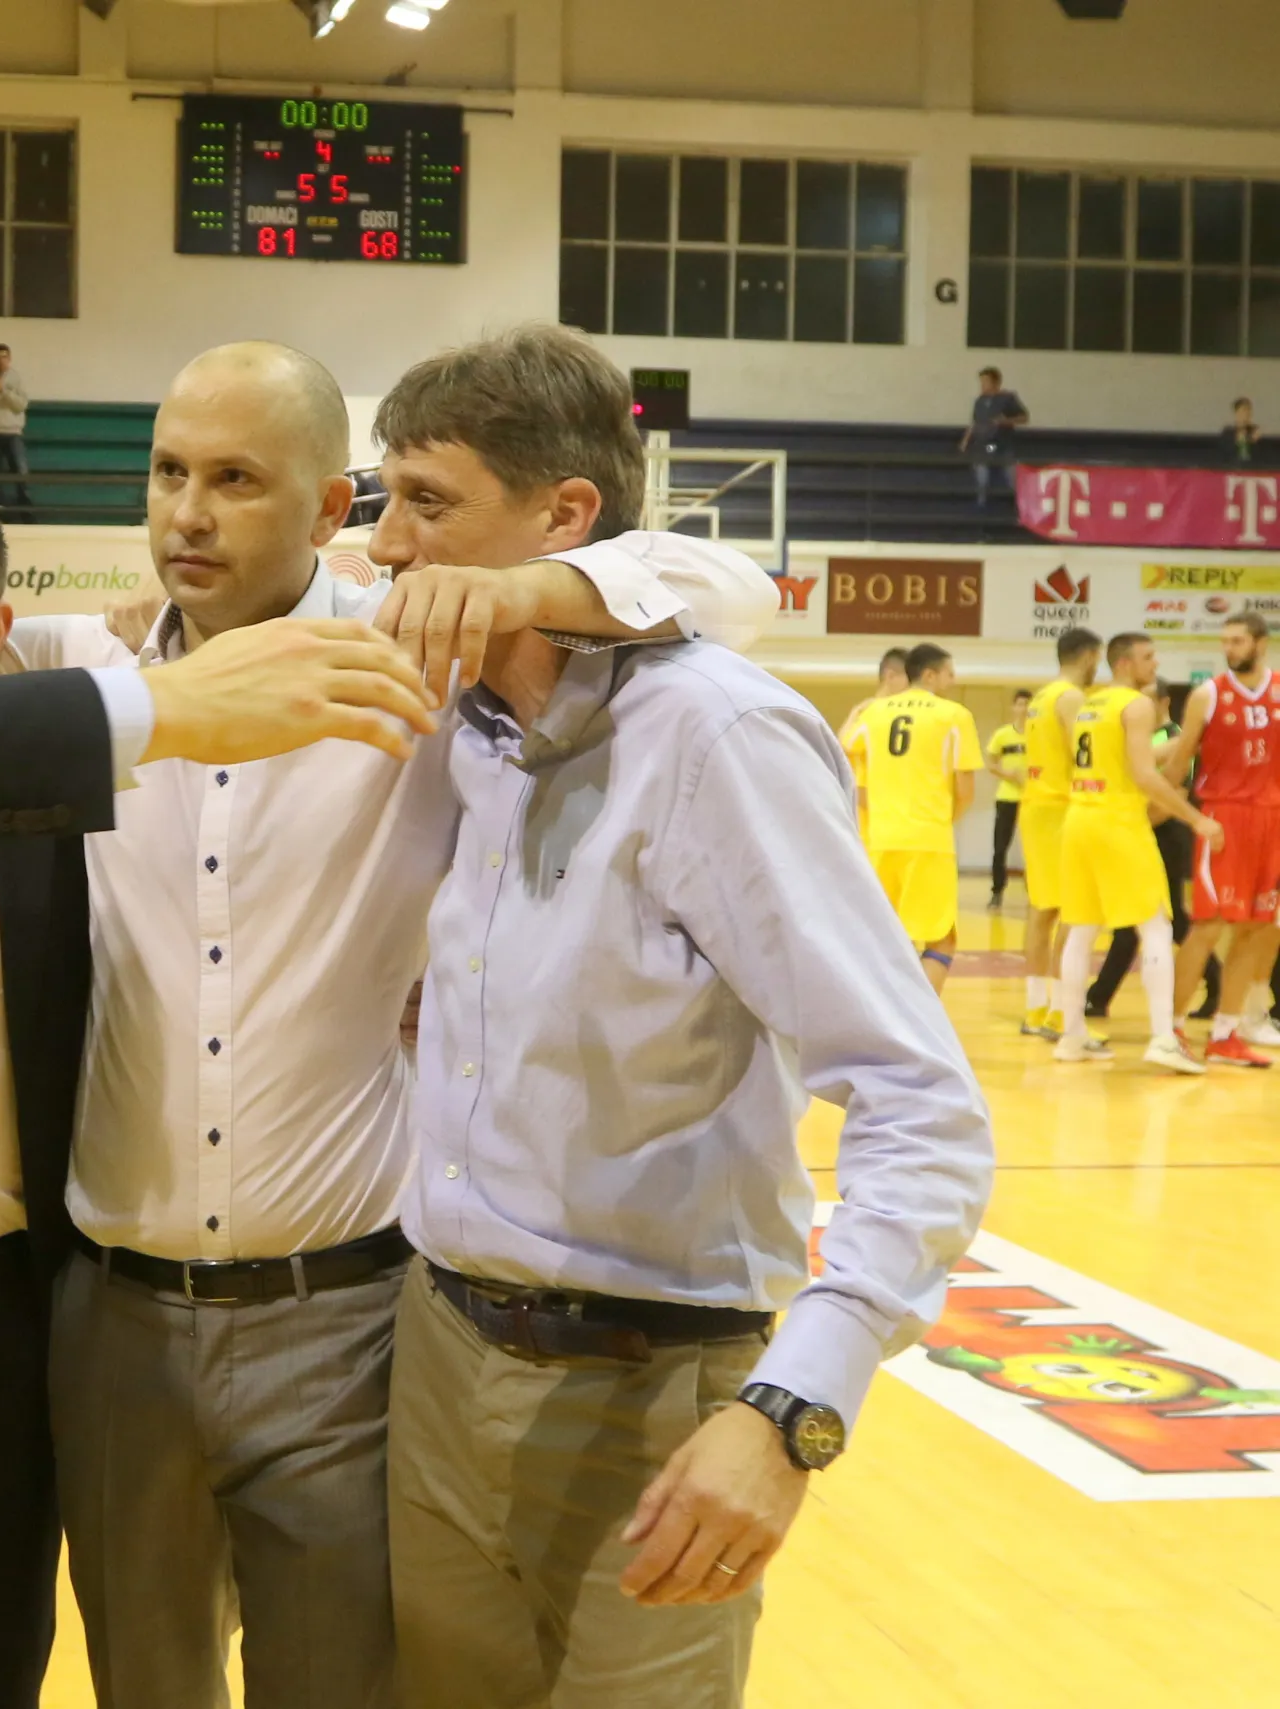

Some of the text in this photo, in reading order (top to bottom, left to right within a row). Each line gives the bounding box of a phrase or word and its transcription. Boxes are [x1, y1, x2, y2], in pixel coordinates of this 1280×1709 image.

[281, 100, 368, 130] 00:00
[315, 140, 332, 163] 4
[298, 173, 349, 203] 5 5
[359, 209, 399, 229] GOSTI
[257, 226, 297, 256] 81
[360, 230, 399, 260] 68
[935, 278, 958, 303] G
[1040, 469, 1090, 538] T
[1225, 475, 1277, 545] T
[833, 572, 978, 607] BOBIS
[1168, 567, 1244, 588] REPLY
[1033, 606, 1090, 622] queen
[1033, 621, 1073, 638] med
[1244, 705, 1269, 729] 13
[888, 714, 914, 757] 6
[1076, 731, 1092, 769] 8
